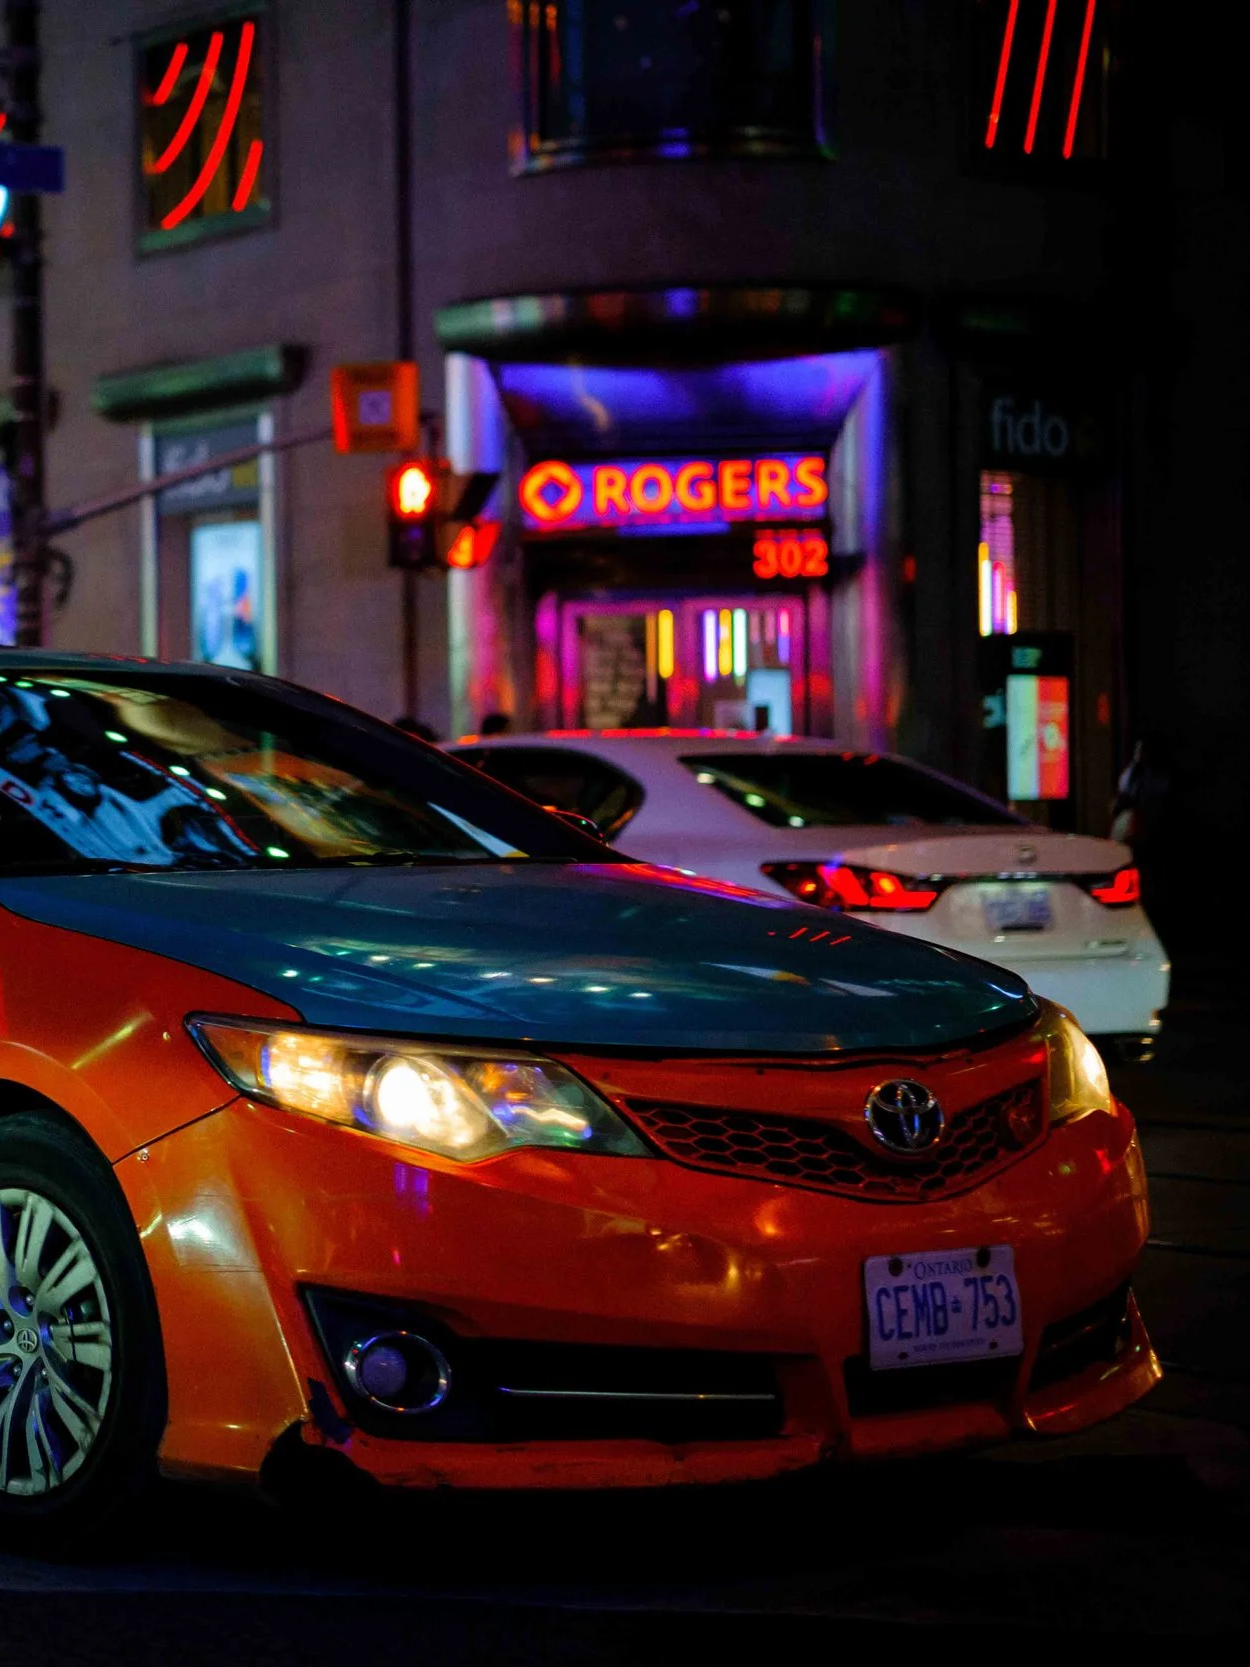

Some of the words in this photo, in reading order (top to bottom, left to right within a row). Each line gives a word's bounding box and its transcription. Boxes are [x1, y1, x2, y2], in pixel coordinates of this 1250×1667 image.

[991, 397, 1069, 457] fido
[593, 457, 829, 515] ROGERS
[753, 538, 829, 578] 302
[876, 1281, 949, 1341] CEMB
[964, 1273, 1016, 1332] 753
